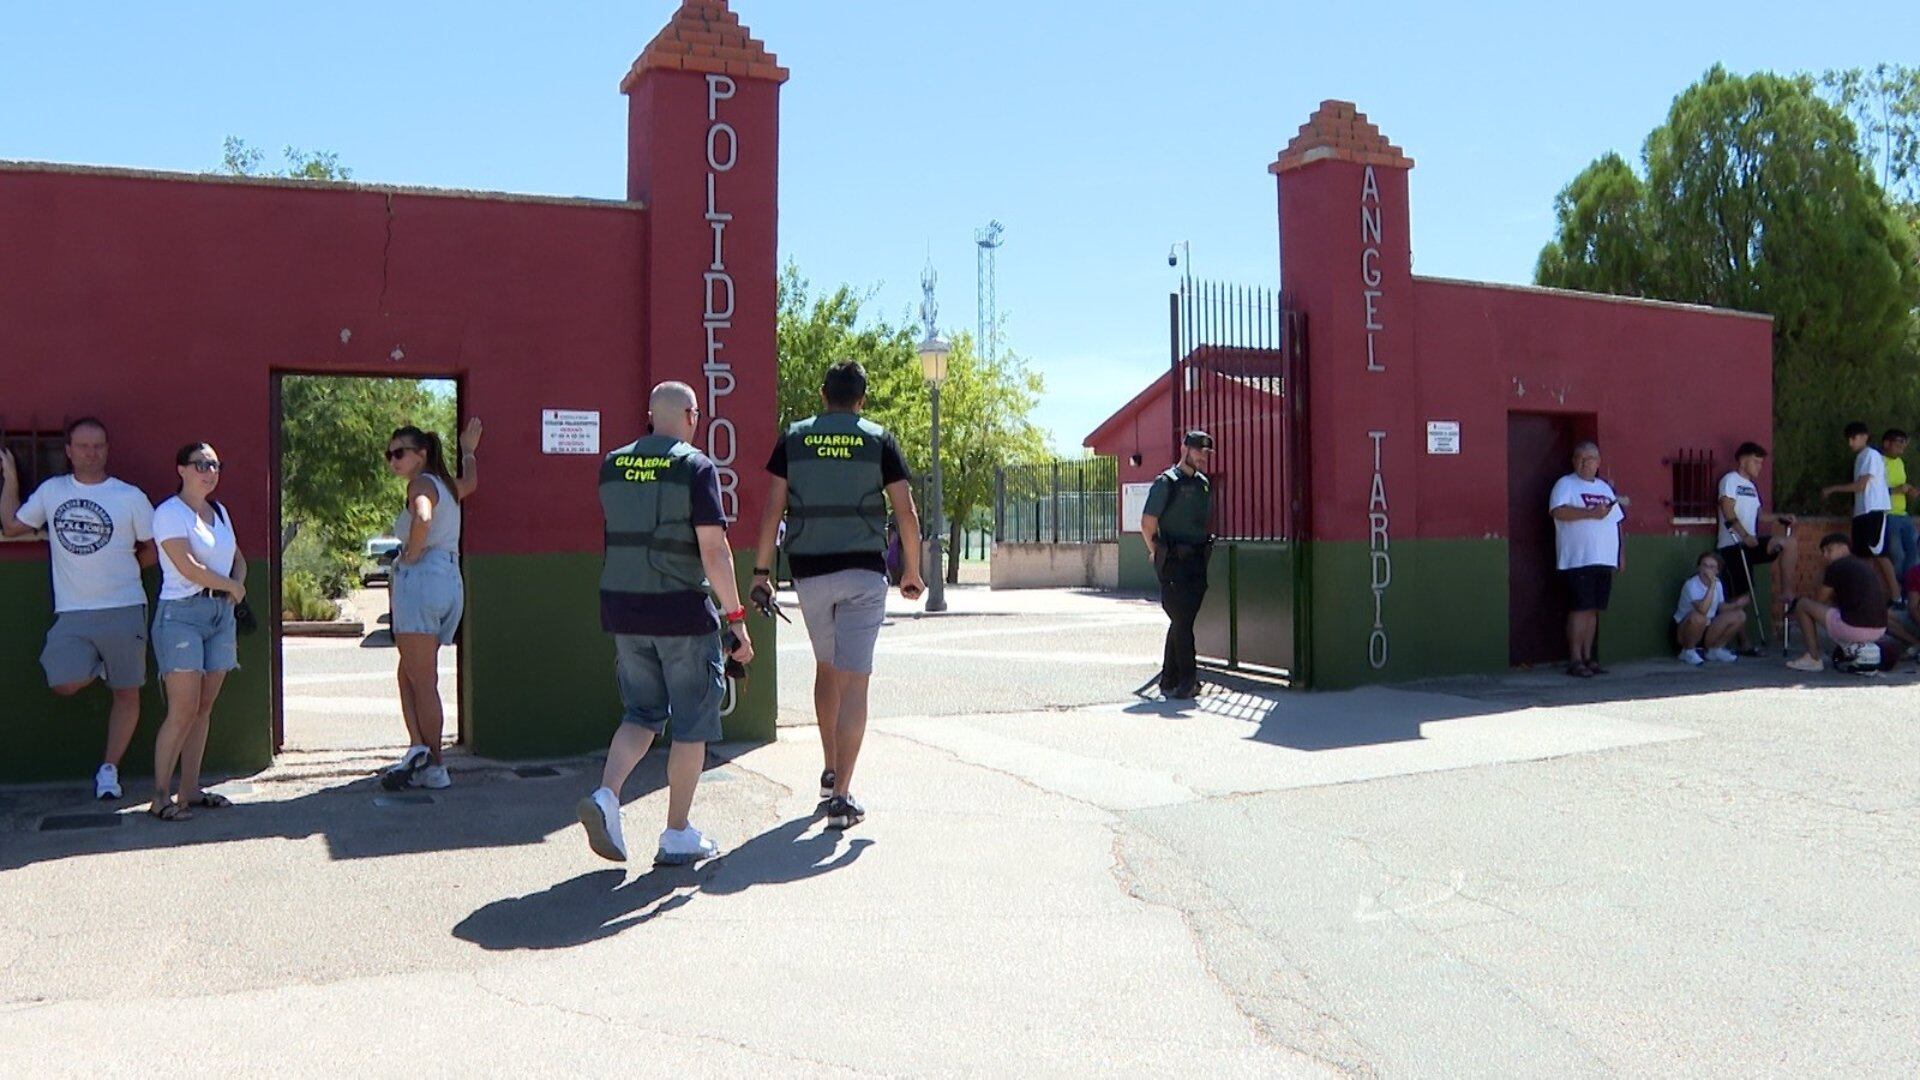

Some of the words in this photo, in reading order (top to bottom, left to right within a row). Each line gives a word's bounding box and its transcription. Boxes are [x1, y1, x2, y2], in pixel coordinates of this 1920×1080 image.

[1361, 165, 1386, 372] ANGEL
[702, 74, 739, 717] POLIDEPOR
[803, 434, 864, 446] GUARDIA
[816, 445, 852, 459] CIVIL
[614, 455, 671, 468] GUARDIA
[624, 468, 657, 482] CIVIL
[1367, 431, 1392, 669] TARDIO
